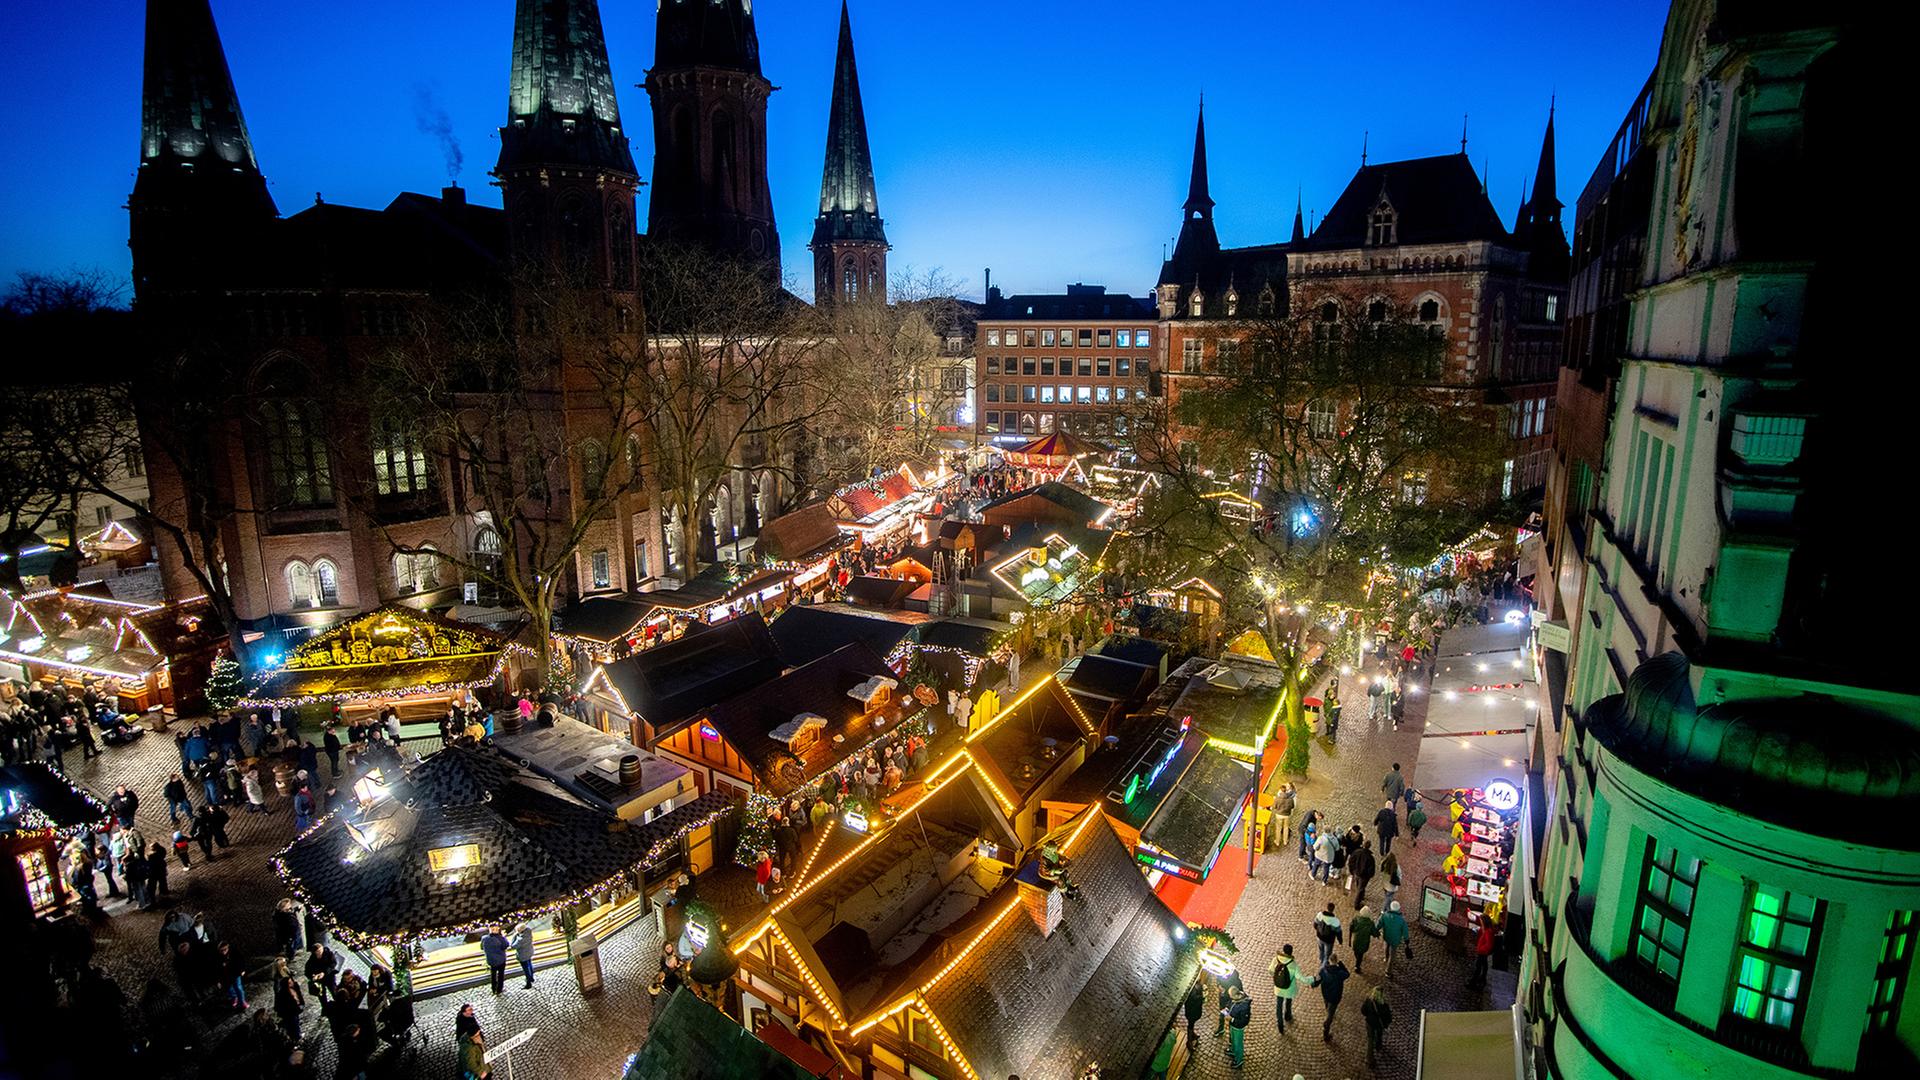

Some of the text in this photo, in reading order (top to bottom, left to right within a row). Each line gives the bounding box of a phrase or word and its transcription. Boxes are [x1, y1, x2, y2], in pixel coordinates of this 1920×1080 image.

[1491, 787, 1512, 804] MA
[1137, 854, 1160, 867] PASTA
[487, 1037, 521, 1058] Toiletten
